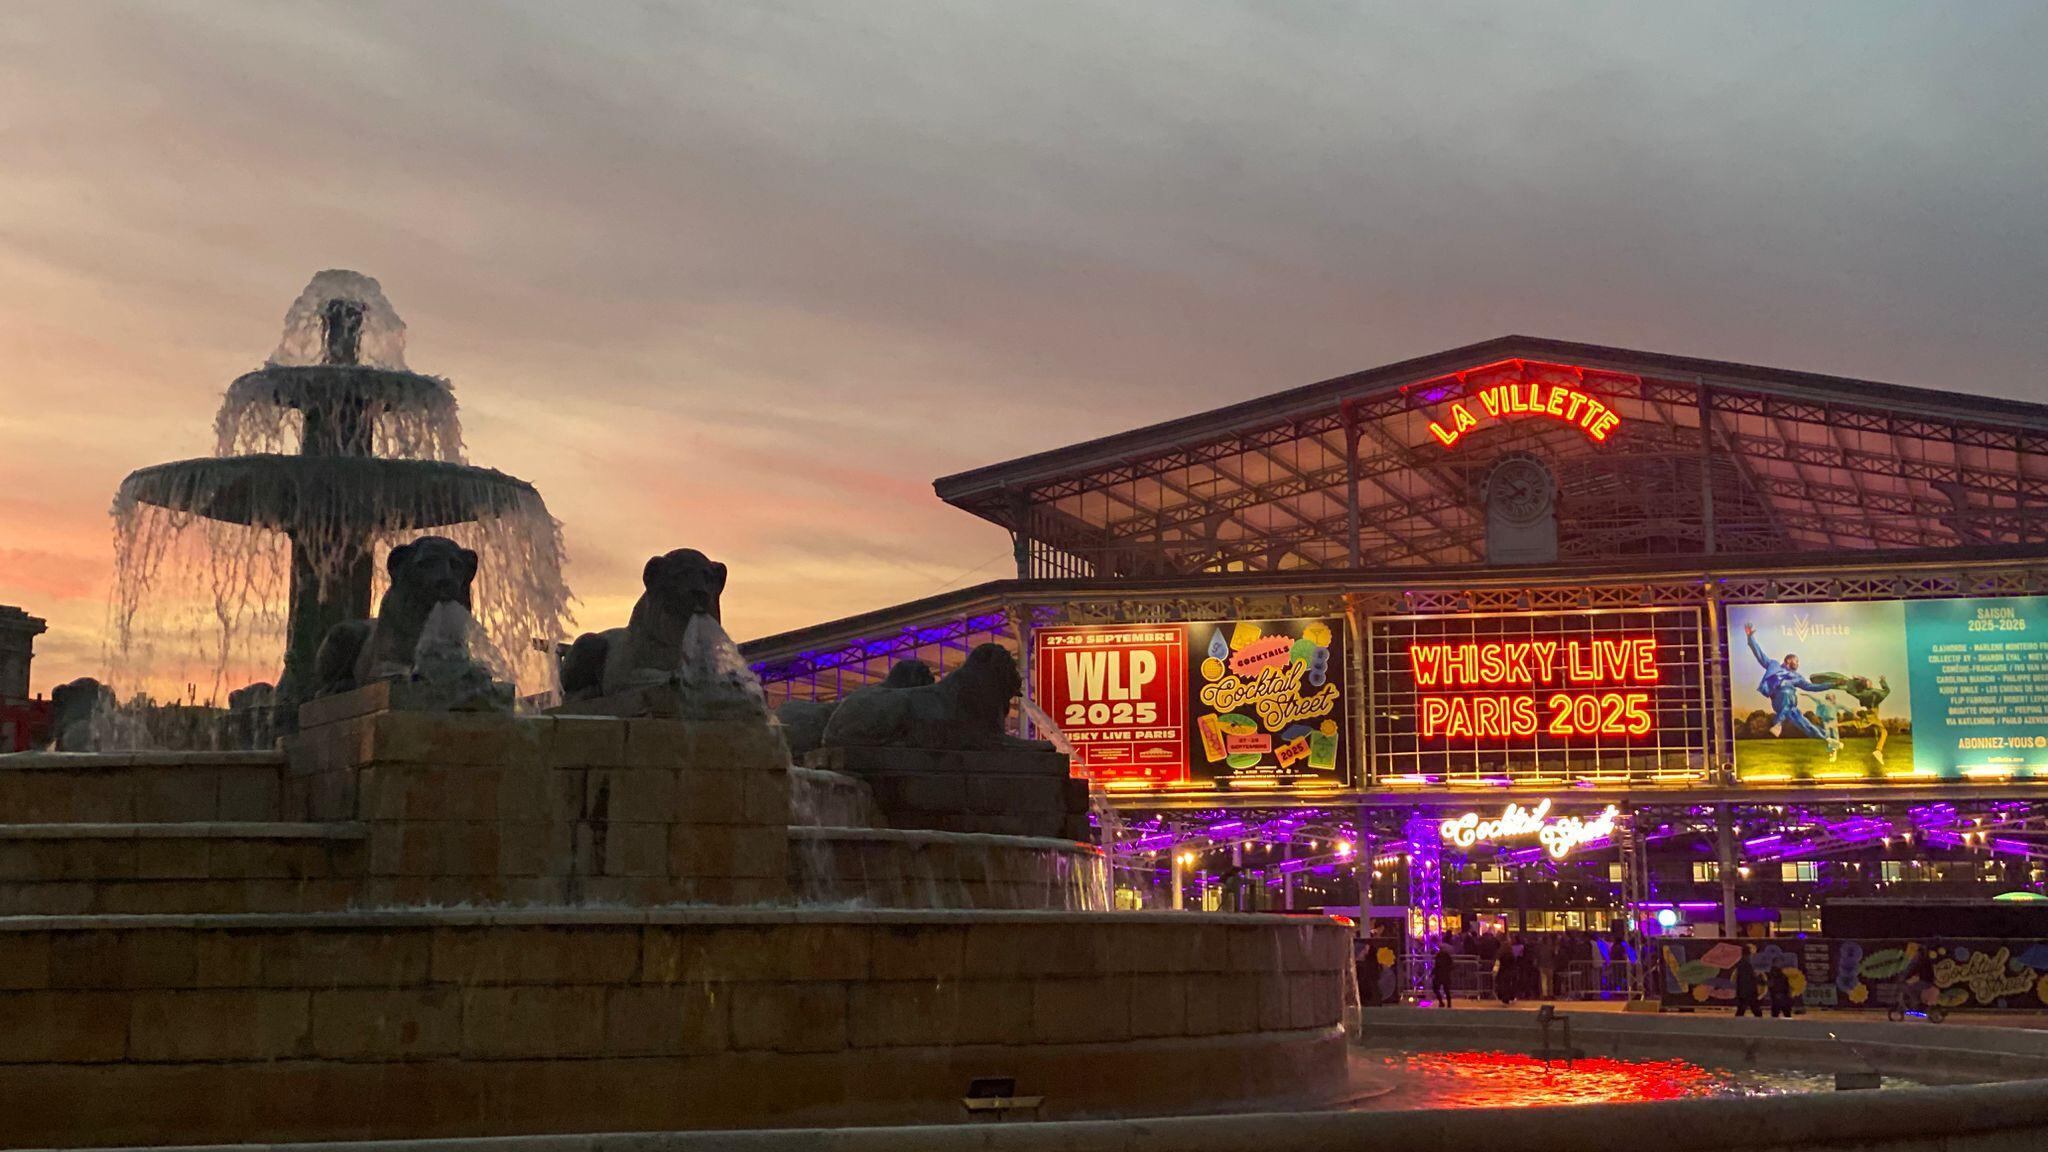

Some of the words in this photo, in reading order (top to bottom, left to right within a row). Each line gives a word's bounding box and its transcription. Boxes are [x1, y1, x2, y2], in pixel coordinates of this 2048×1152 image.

[1429, 404, 1477, 445] LA
[1479, 383, 1620, 440] VILLETTE
[1968, 619, 2026, 631] 2025-2026
[1977, 607, 2015, 619] SAISON
[1047, 635, 1083, 646] 27-29
[1087, 632, 1175, 644] SEPTEMBRE
[1237, 645, 1290, 667] COCKTAILS
[1065, 650, 1156, 701] WLP
[1410, 641, 1558, 686] WHISKY
[1568, 639, 1659, 682] LIVE
[1203, 661, 1303, 708] Cocktail
[1065, 702, 1157, 725] 2025
[1259, 686, 1335, 728] Street
[1422, 695, 1538, 737] PARIS
[1548, 692, 1652, 736] 2025
[1102, 731, 1133, 740] LIVE
[1137, 730, 1176, 739] PARIS
[1281, 743, 1305, 760] 2025
[1959, 736, 2034, 749] ABONNEZ-VOUS
[1440, 798, 1552, 847] Cocktail
[1540, 805, 1619, 859] Street
[1935, 949, 2009, 985] Cocktail
[1971, 970, 2034, 1003] Street
